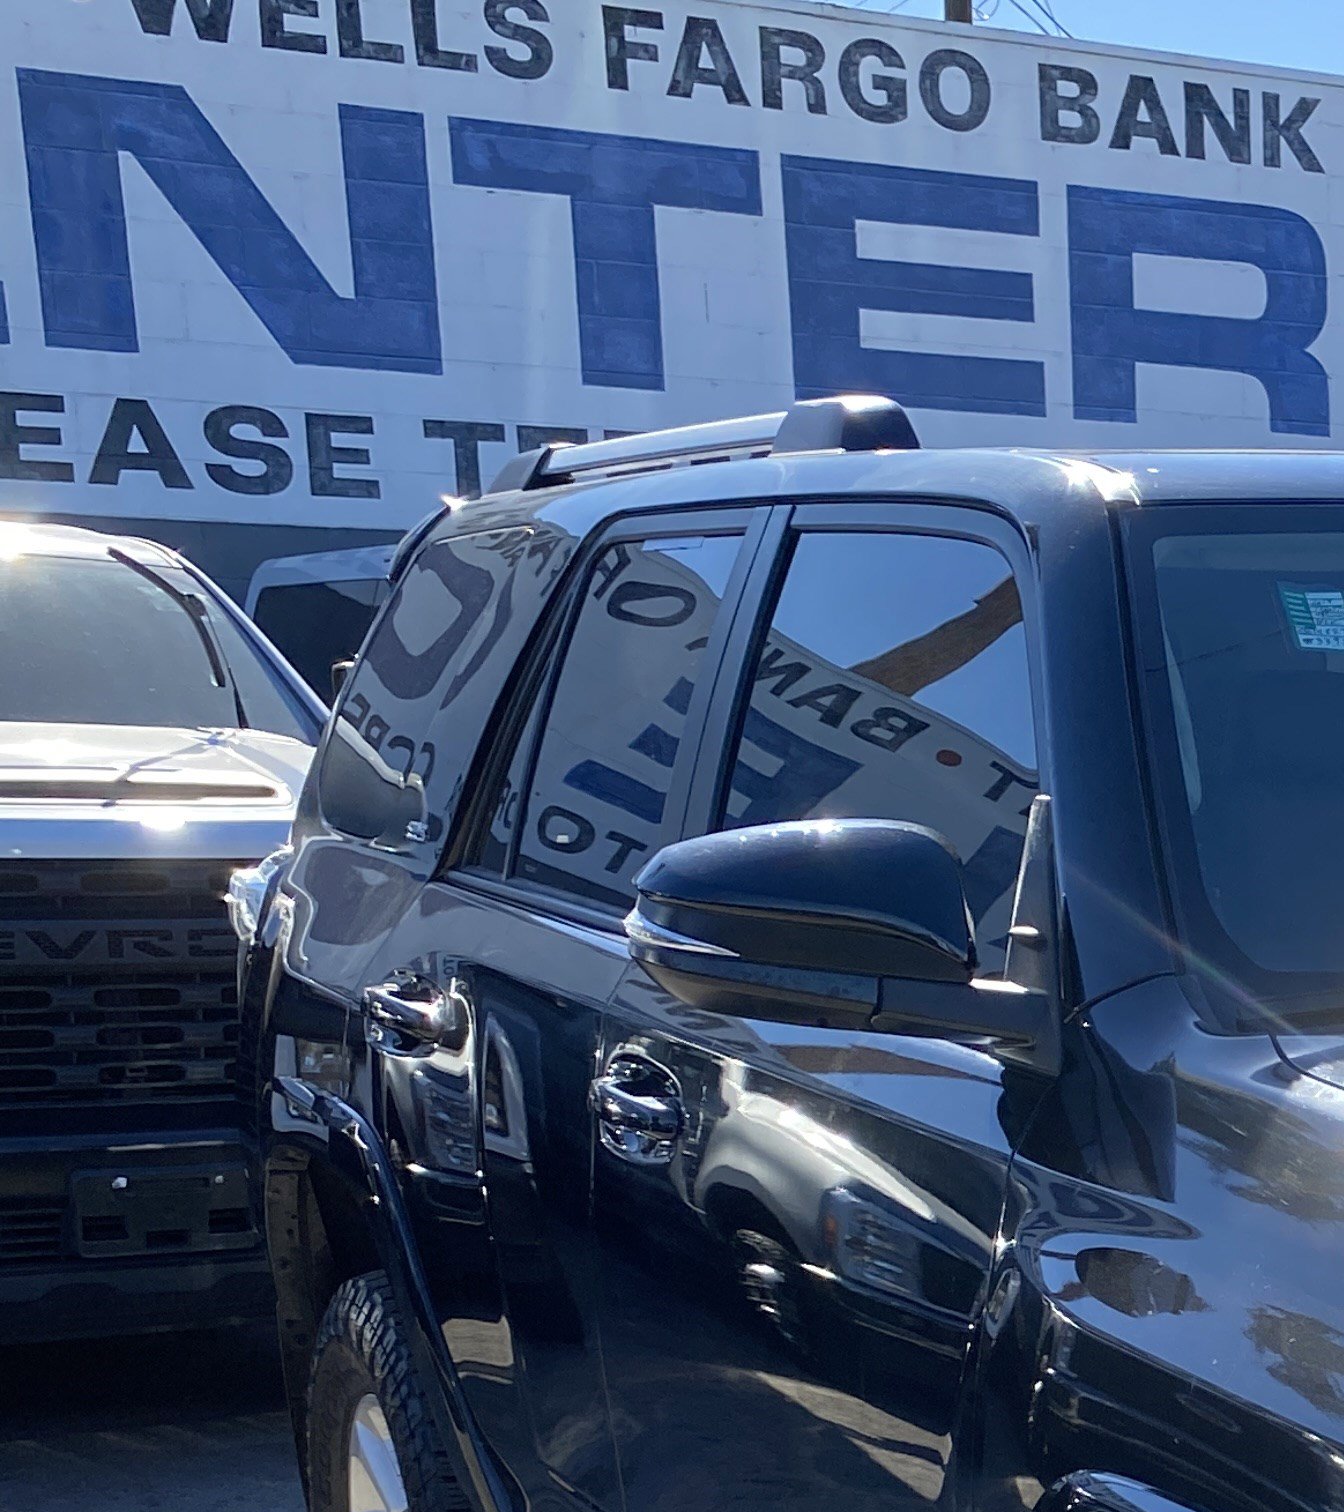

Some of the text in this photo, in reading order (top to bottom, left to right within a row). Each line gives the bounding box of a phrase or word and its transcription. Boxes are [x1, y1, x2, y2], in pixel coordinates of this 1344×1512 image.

[603, 7, 991, 132] FARGO
[1036, 63, 1326, 174] BANK
[0, 66, 1331, 438] NTER
